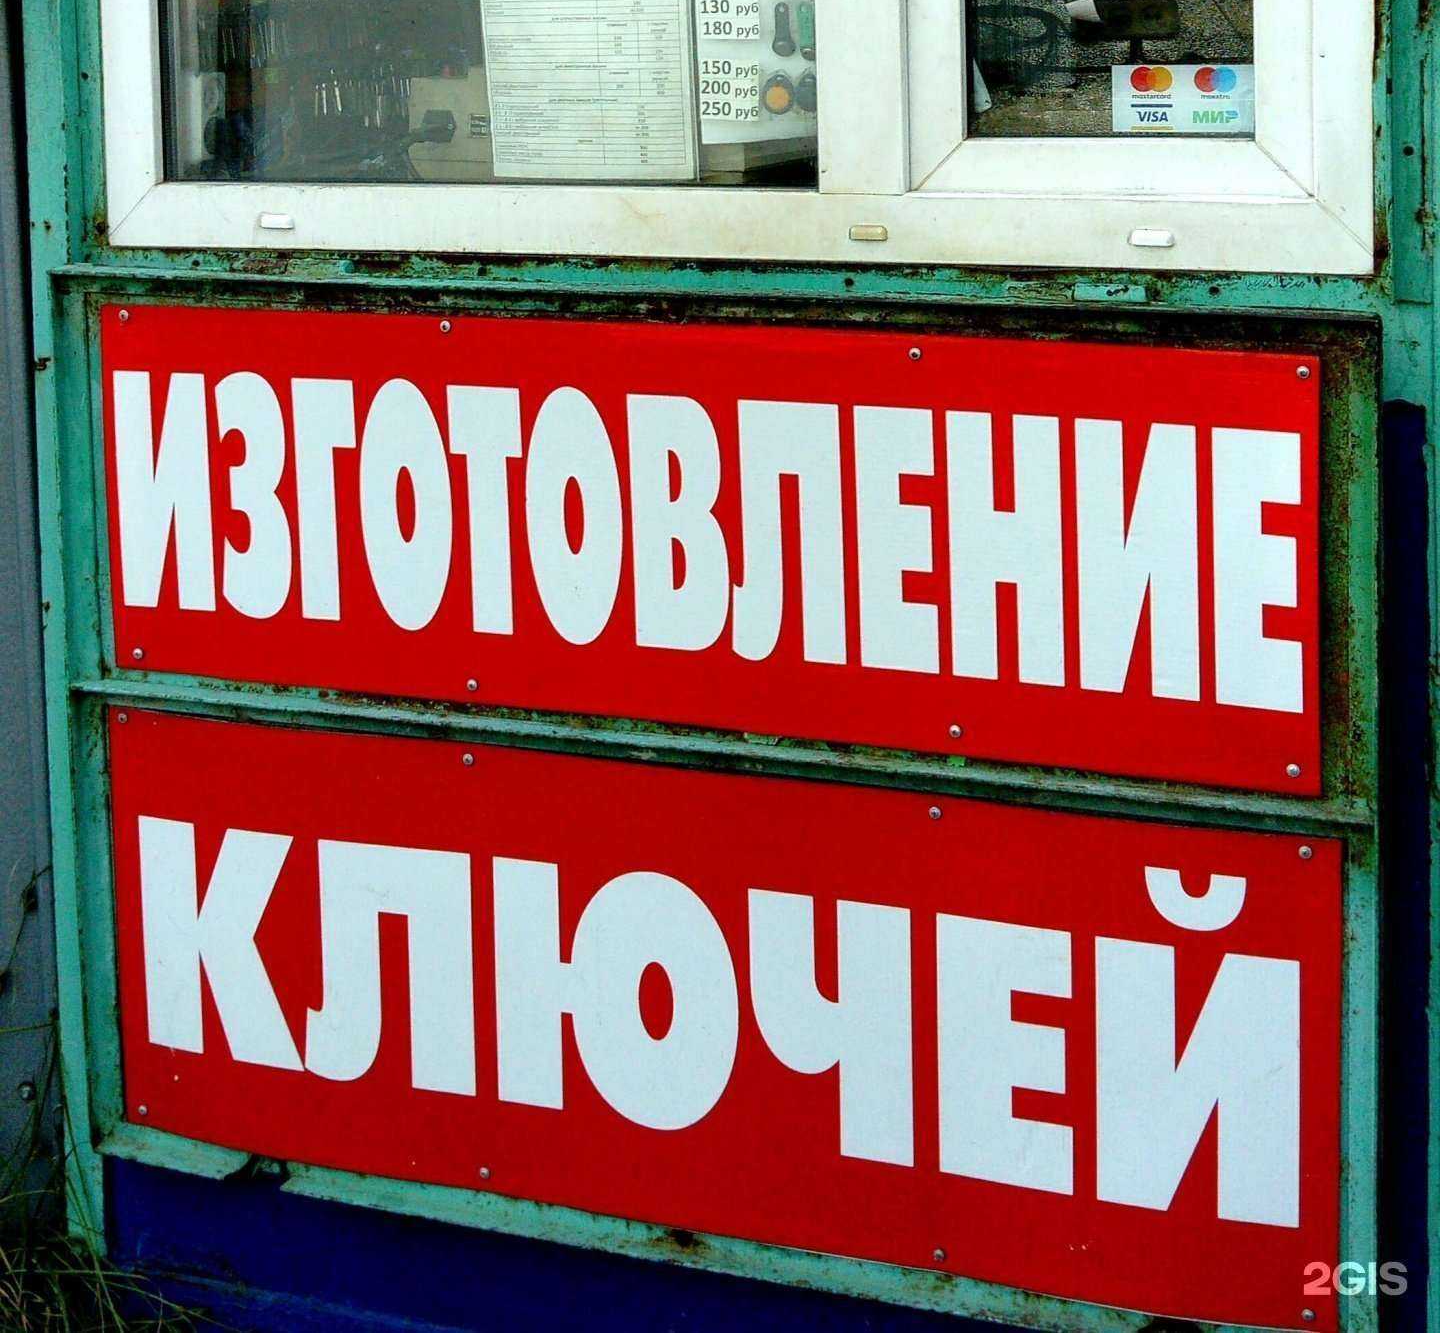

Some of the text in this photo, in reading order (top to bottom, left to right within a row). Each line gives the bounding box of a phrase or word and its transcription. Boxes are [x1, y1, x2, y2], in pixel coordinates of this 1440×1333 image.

[700, 0, 759, 16] 130 руб
[703, 20, 760, 38] 180 руб
[702, 60, 758, 78] 150 руб
[701, 80, 758, 99] 200 руб
[701, 101, 759, 119] 250 руб
[1136, 110, 1169, 123] VISA
[1192, 110, 1239, 124] МИР
[112, 370, 1304, 714] ИЗГОТОВЛЕНИЕ
[137, 814, 1301, 1229] КЛЮЧЕЙ
